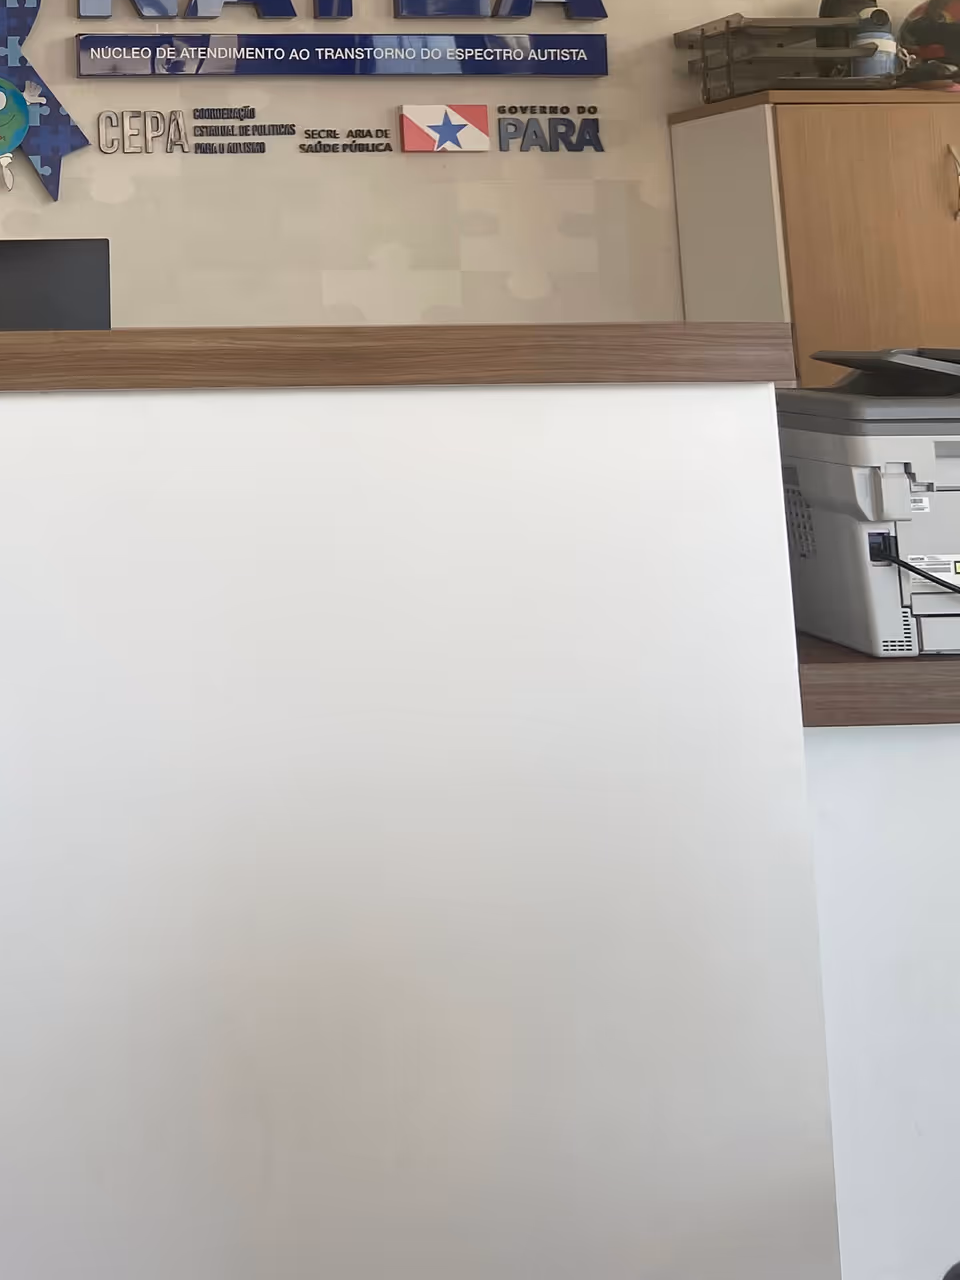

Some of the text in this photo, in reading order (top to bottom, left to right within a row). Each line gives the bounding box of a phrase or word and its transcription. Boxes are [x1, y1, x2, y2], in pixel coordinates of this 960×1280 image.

[90, 46, 588, 62] NÚCLEO DE ATENDIMENTO AO TRANSTORNO DO ESPECTRO AUTISTA
[497, 105, 598, 115] GOVERNO DO
[97, 110, 190, 154] CEPA
[239, 125, 251, 136] DE
[375, 129, 391, 138] DE
[298, 140, 393, 153] SAÚDE PÚBLICA
